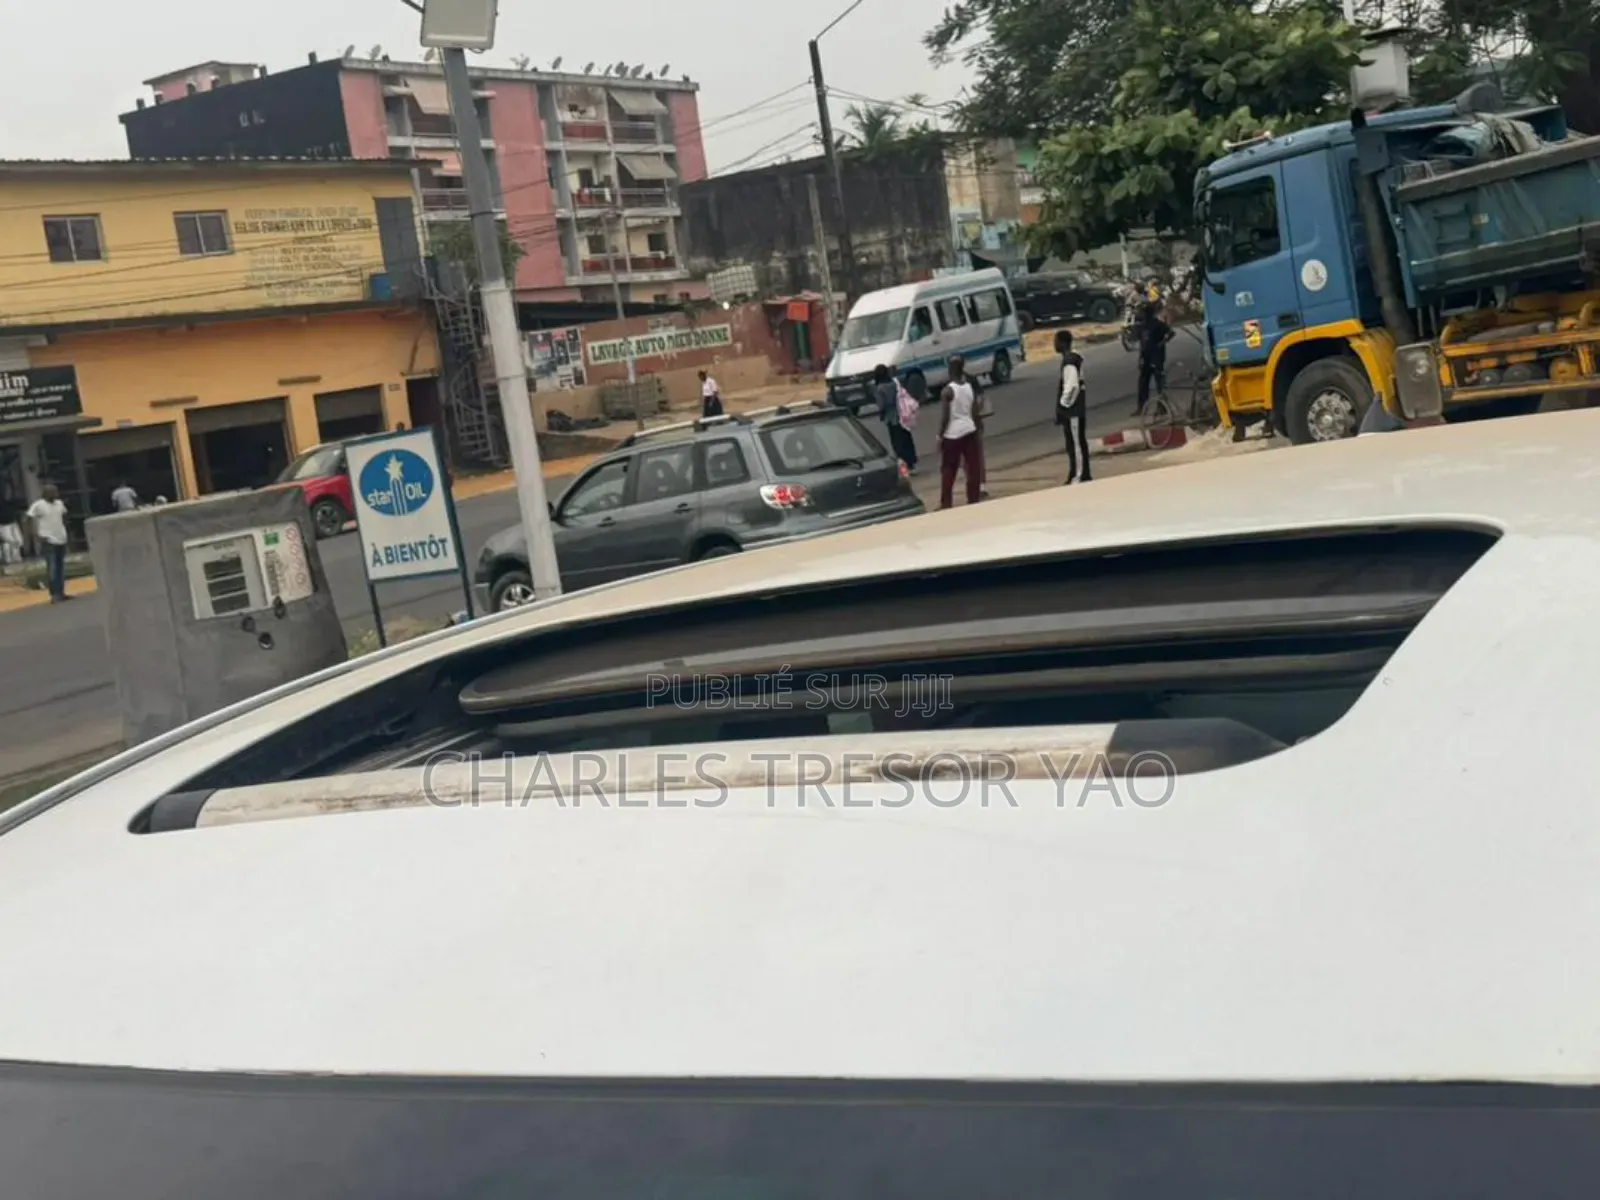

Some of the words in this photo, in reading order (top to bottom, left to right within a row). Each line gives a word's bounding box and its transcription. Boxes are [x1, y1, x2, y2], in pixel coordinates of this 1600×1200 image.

[636, 336, 666, 354] AUTO
[367, 489, 393, 506] star
[371, 542, 383, 568] À
[384, 534, 448, 565] BIENTÔT
